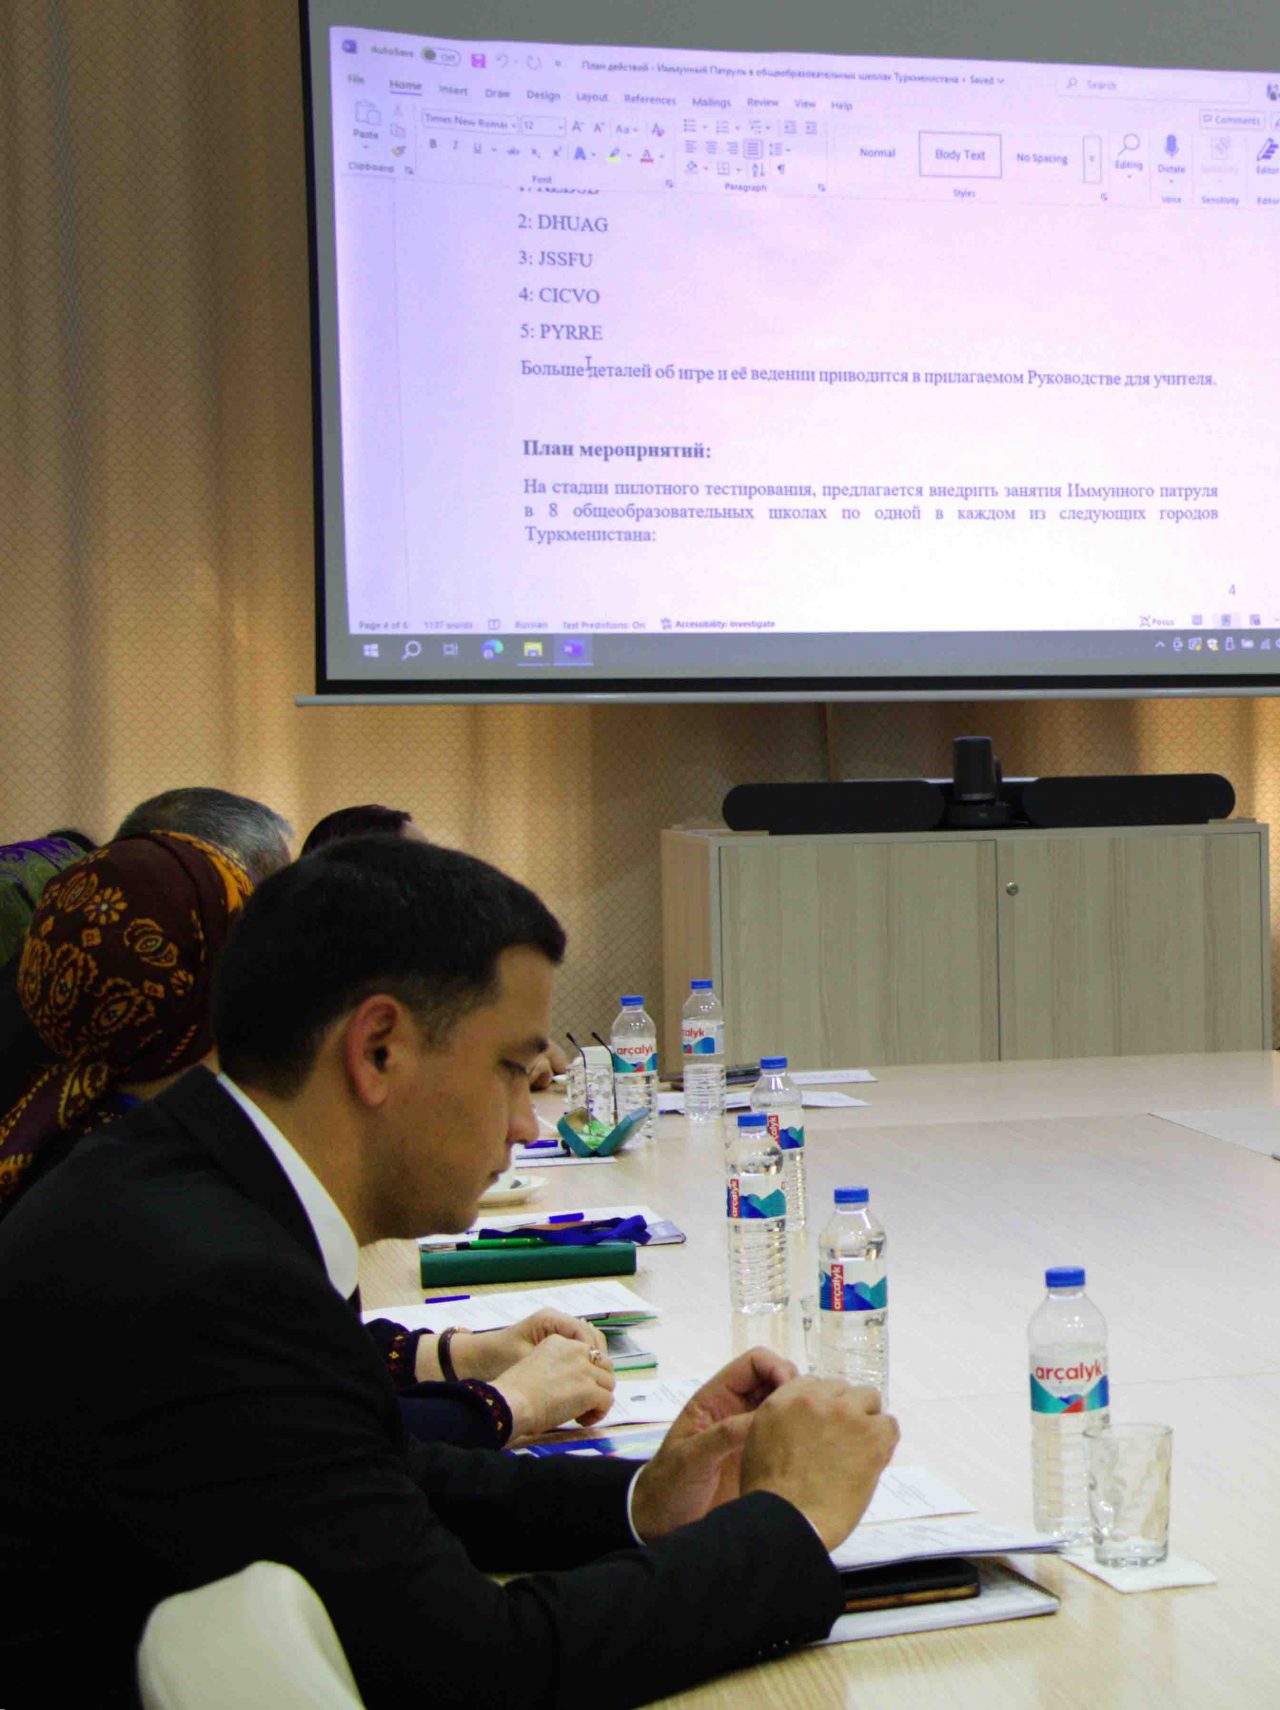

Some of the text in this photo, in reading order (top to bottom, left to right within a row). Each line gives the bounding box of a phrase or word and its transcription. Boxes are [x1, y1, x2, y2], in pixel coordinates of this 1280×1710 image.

[389, 80, 422, 91] Home
[438, 84, 469, 96] Insert
[485, 88, 511, 99] Draw
[526, 89, 562, 103] Design
[576, 92, 608, 105] Layout
[624, 93, 677, 107] References
[692, 97, 732, 110] Mailings
[747, 97, 780, 108] Review
[794, 98, 816, 109] View
[831, 100, 853, 112] Help
[426, 112, 452, 124] Times
[454, 115, 476, 127] New
[524, 120, 534, 131] 12
[1215, 114, 1262, 126] Comments
[353, 127, 379, 140] Paste
[860, 147, 896, 158] Normal
[935, 148, 986, 162] Body Text
[1016, 152, 1068, 166] No Spacing
[348, 161, 394, 175] Clipboard
[1115, 159, 1144, 172] Editing
[1158, 163, 1186, 175] Dictate
[1256, 164, 1280, 176] Editor
[532, 174, 553, 185] Font
[724, 181, 768, 194] Paragraph
[953, 188, 976, 200] Styles
[517, 213, 609, 234] 2: DHUAG
[517, 250, 594, 269] 3: JSSFU
[518, 286, 601, 305] 4: CICVO
[519, 323, 604, 342] 5: PYRRE
[520, 359, 1218, 389] Больше деталей об игре и её ведении приводится в прилагаемом Руководстве для учителя.
[522, 439, 712, 463] План мероприятий:
[524, 478, 1219, 502] На стадии пилотного тестирования, предлагается внедрить занятия Иммунного патруля
[524, 502, 1219, 524] в 8 общеобразовательных школах по одной в каждом из следующих городов
[523, 525, 656, 545] Туркменистана:
[1228, 584, 1237, 597] 4
[515, 621, 549, 630] Russian
[1151, 617, 1176, 628] Focus
[1035, 1359, 1103, 1385] arçalyk
